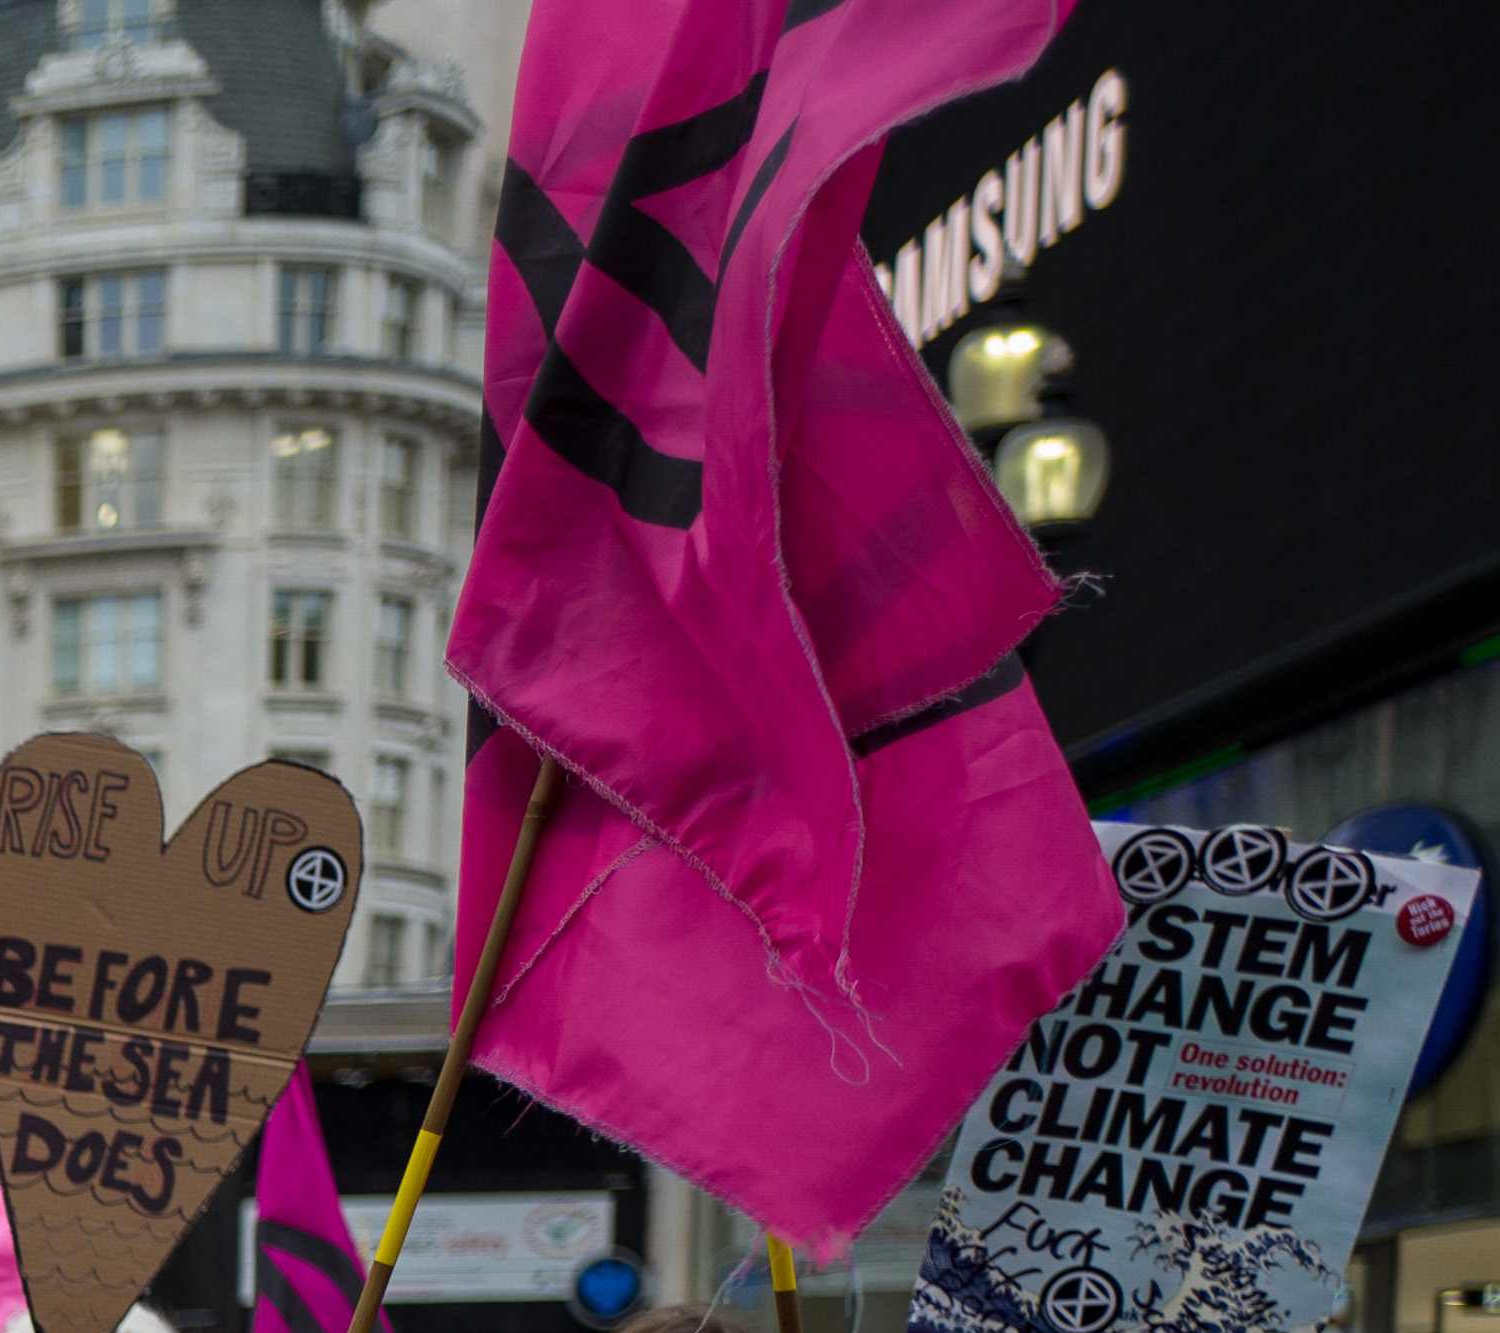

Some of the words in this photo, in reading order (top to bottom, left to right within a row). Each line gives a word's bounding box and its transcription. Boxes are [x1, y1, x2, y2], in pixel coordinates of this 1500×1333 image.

[874, 66, 1128, 352] AMSUNG
[203, 800, 308, 900] UP
[1116, 902, 1372, 988] STEM
[1006, 1019, 1173, 1087] NOT
[1058, 963, 1368, 1055] HANGE
[102, 1030, 231, 1126] SEA
[1172, 1070, 1299, 1106] revolution
[1178, 1041, 1230, 1070] One
[1236, 1050, 1348, 1089] solution:
[11, 1113, 183, 1215] DOES
[989, 1078, 1335, 1180] CLIMATE
[969, 1136, 1306, 1231] CHANGE
